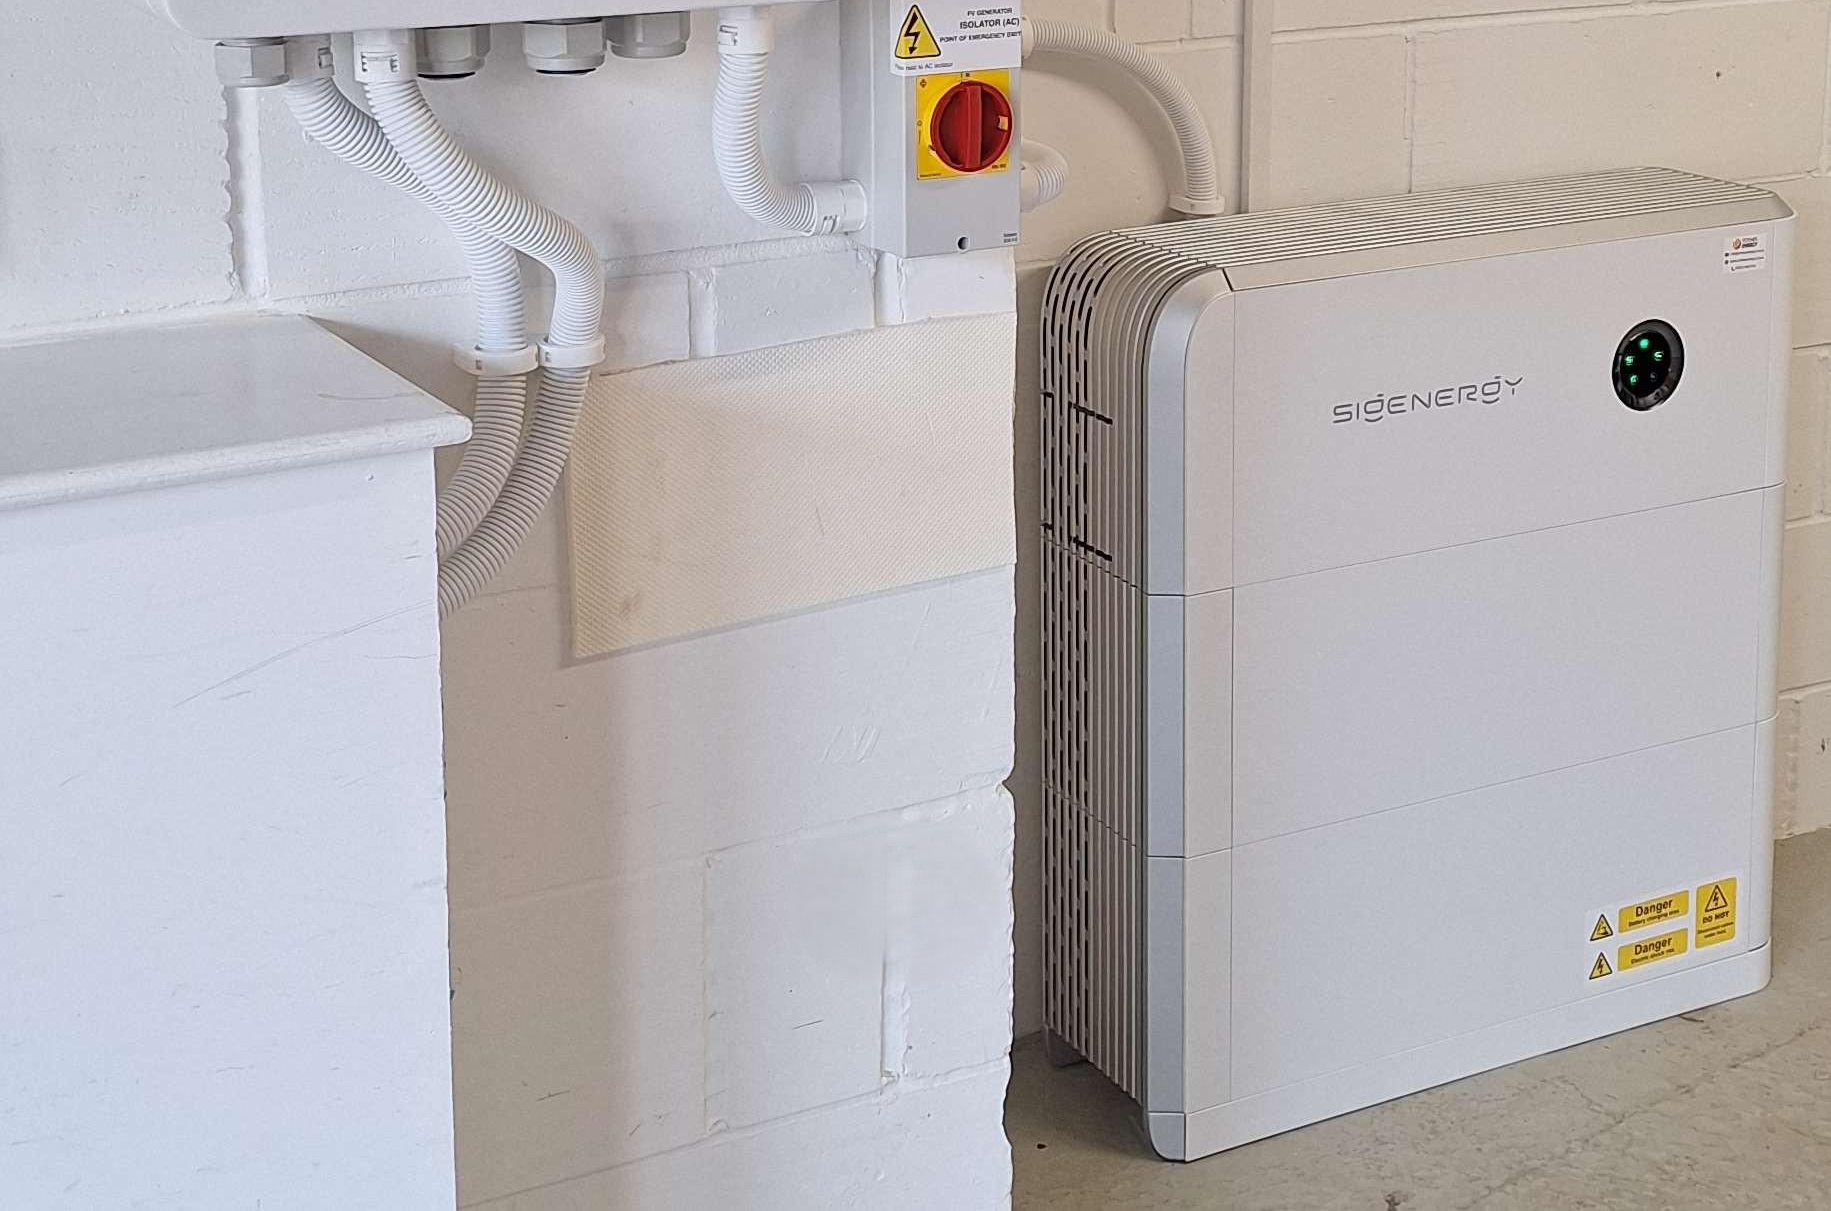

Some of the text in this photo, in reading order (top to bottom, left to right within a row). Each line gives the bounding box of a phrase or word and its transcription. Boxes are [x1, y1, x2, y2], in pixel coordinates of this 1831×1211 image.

[977, 7, 1013, 16] GENERATOR
[960, 18, 1020, 30] ISOLATOR (AC)
[940, 34, 957, 43] POINT
[960, 34, 967, 42] OF
[969, 32, 1005, 41] EMERGENCY
[1635, 899, 1673, 918] Danger
[1634, 937, 1672, 956] Danger
